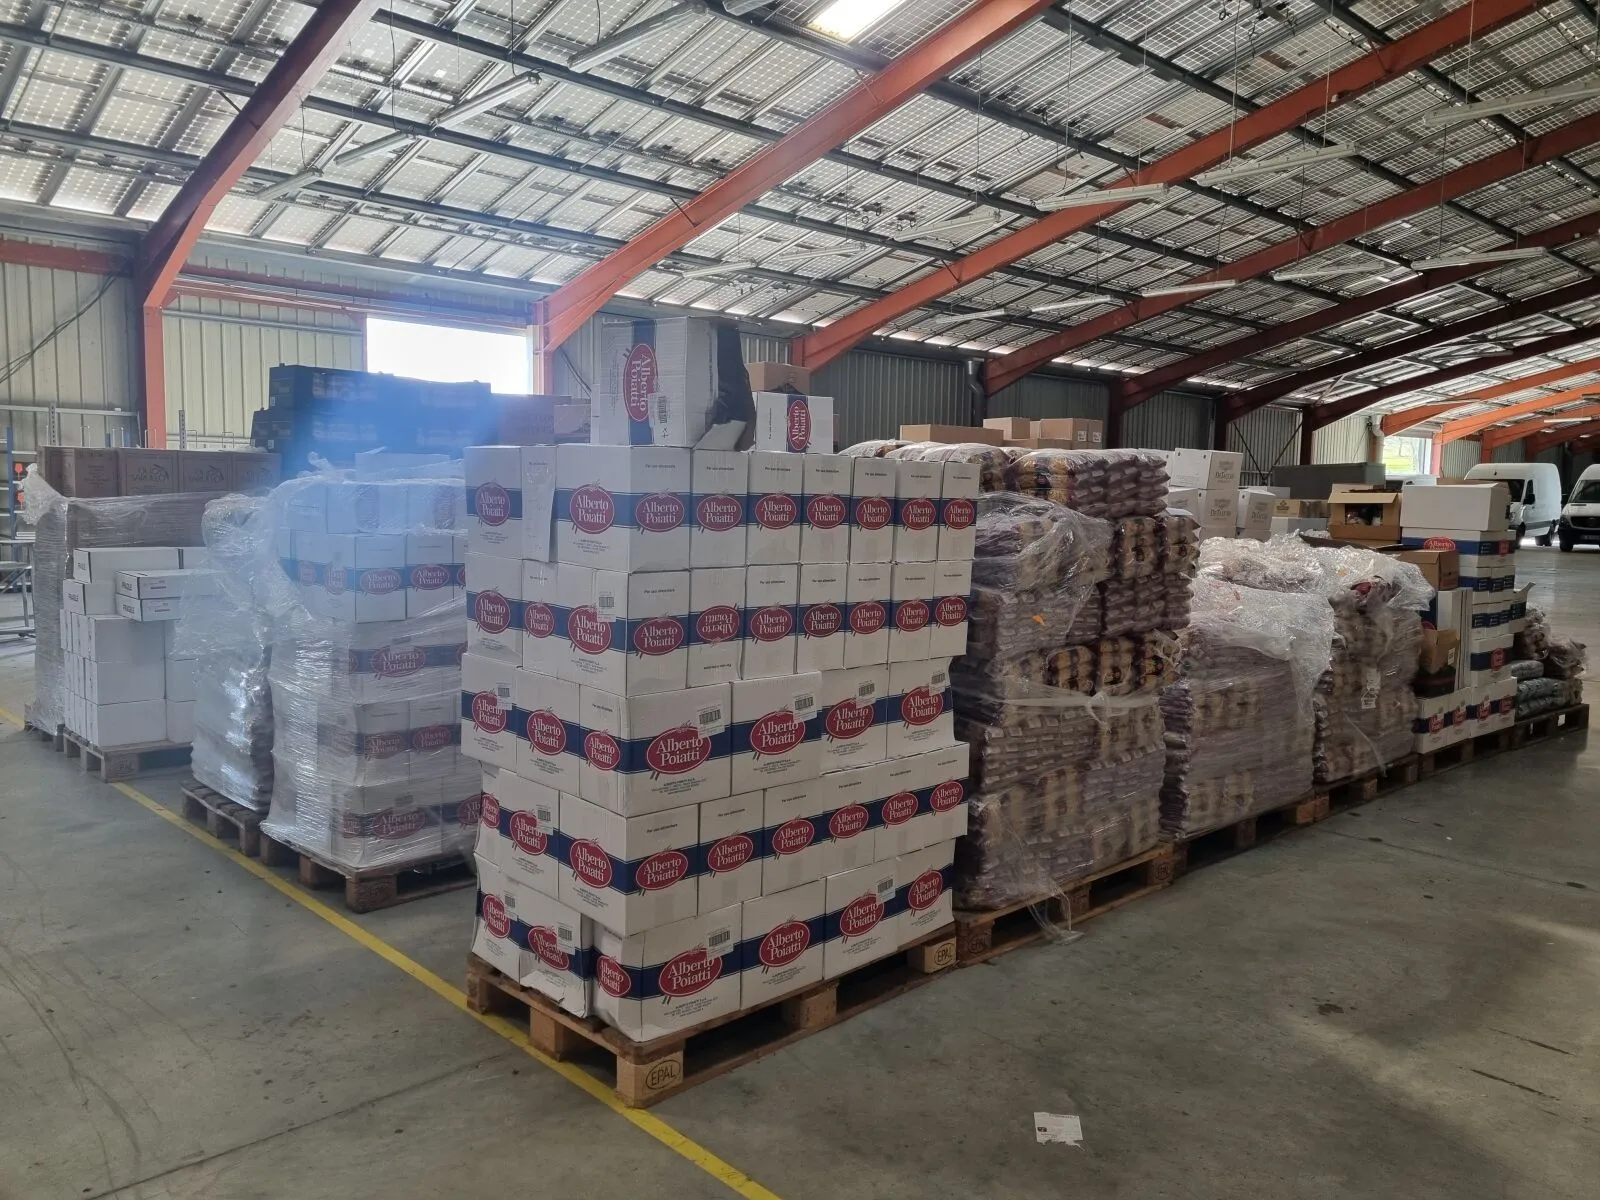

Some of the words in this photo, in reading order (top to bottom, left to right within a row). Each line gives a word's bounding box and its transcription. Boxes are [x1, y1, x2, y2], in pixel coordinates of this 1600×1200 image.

[631, 360, 641, 407] Poiatti
[640, 353, 651, 412] Alberto
[480, 493, 506, 505] Alberto
[575, 495, 609, 510] Alberto
[761, 500, 792, 512] Alberto
[481, 504, 504, 517] Poiatti
[643, 500, 679, 513] Alberto
[703, 501, 737, 513] Alberto
[812, 502, 841, 513] Alberto
[861, 504, 887, 514] Alberto
[907, 505, 932, 515] Alberto
[948, 505, 971, 515] Alberto
[578, 508, 606, 524] Poiatti
[645, 512, 676, 524] Poiatti
[706, 512, 734, 524] Poiatti
[763, 511, 789, 522] Poiatti
[815, 511, 839, 522] Poiatti
[863, 513, 885, 523] Poiatti
[908, 514, 930, 524] Poiatti
[949, 513, 969, 523] Poiatti
[416, 570, 445, 579] Alberto
[478, 598, 506, 616] Alberto
[855, 608, 882, 619] Alberto
[900, 607, 926, 617] Alberto
[939, 603, 964, 612] Alberto
[480, 610, 503, 626] Poiatti
[528, 609, 550, 622] Alberto
[705, 613, 733, 624] Poiatti
[757, 613, 788, 625] Alberto
[809, 610, 838, 621] Alberto
[902, 615, 923, 625] Poiatti
[941, 611, 962, 621] Poiatti
[529, 620, 549, 632] Poiatti
[573, 614, 606, 632] Alberto
[702, 623, 736, 634] Alberto
[759, 623, 786, 635] Poiatti
[811, 619, 835, 631] Poiatti
[857, 618, 880, 628] Poiatti
[576, 628, 603, 646] Poiatti
[641, 625, 678, 638] Alberto
[644, 635, 675, 649] Poiatti
[476, 698, 503, 716] Alberto
[908, 695, 939, 708] Alberto
[479, 711, 500, 727] Poiatti
[834, 707, 869, 721] Alberto
[910, 705, 936, 719] Poiatti
[531, 717, 561, 736] Alberto
[758, 720, 799, 736] Alberto
[836, 717, 865, 732] Poiatti
[534, 729, 559, 749] Poiatti
[588, 737, 615, 755] Alberto
[656, 736, 703, 755] Alberto
[762, 731, 795, 748] Poiatti
[590, 748, 612, 765] Poiatti
[660, 748, 700, 767] Poiatti
[934, 786, 960, 799] Alberto
[887, 797, 914, 811] Alberto
[936, 795, 958, 808] Poiatti
[834, 810, 864, 824] Alberto
[889, 807, 912, 820] Poiatti
[514, 816, 543, 837] Alberto
[777, 825, 810, 841] Alberto
[837, 820, 862, 834] Poiatti
[517, 829, 541, 850] Poiatti
[780, 836, 807, 850] Poiatti
[713, 842, 748, 858] Alberto
[575, 846, 607, 871] Alberto
[716, 852, 745, 867] Poiatti
[578, 860, 604, 882] Poiatti
[643, 857, 682, 875] Alberto
[646, 868, 679, 885] Poiatti
[913, 876, 940, 895] Alberto
[915, 888, 938, 906] Poiatti
[846, 902, 879, 921] Alberto
[849, 914, 876, 931] Poiatti
[766, 929, 804, 950] Alberto
[770, 942, 801, 961] Poiatti
[667, 957, 715, 979] Alberto
[671, 969, 712, 991] Poiatti
[650, 1066, 677, 1087] EPAL
